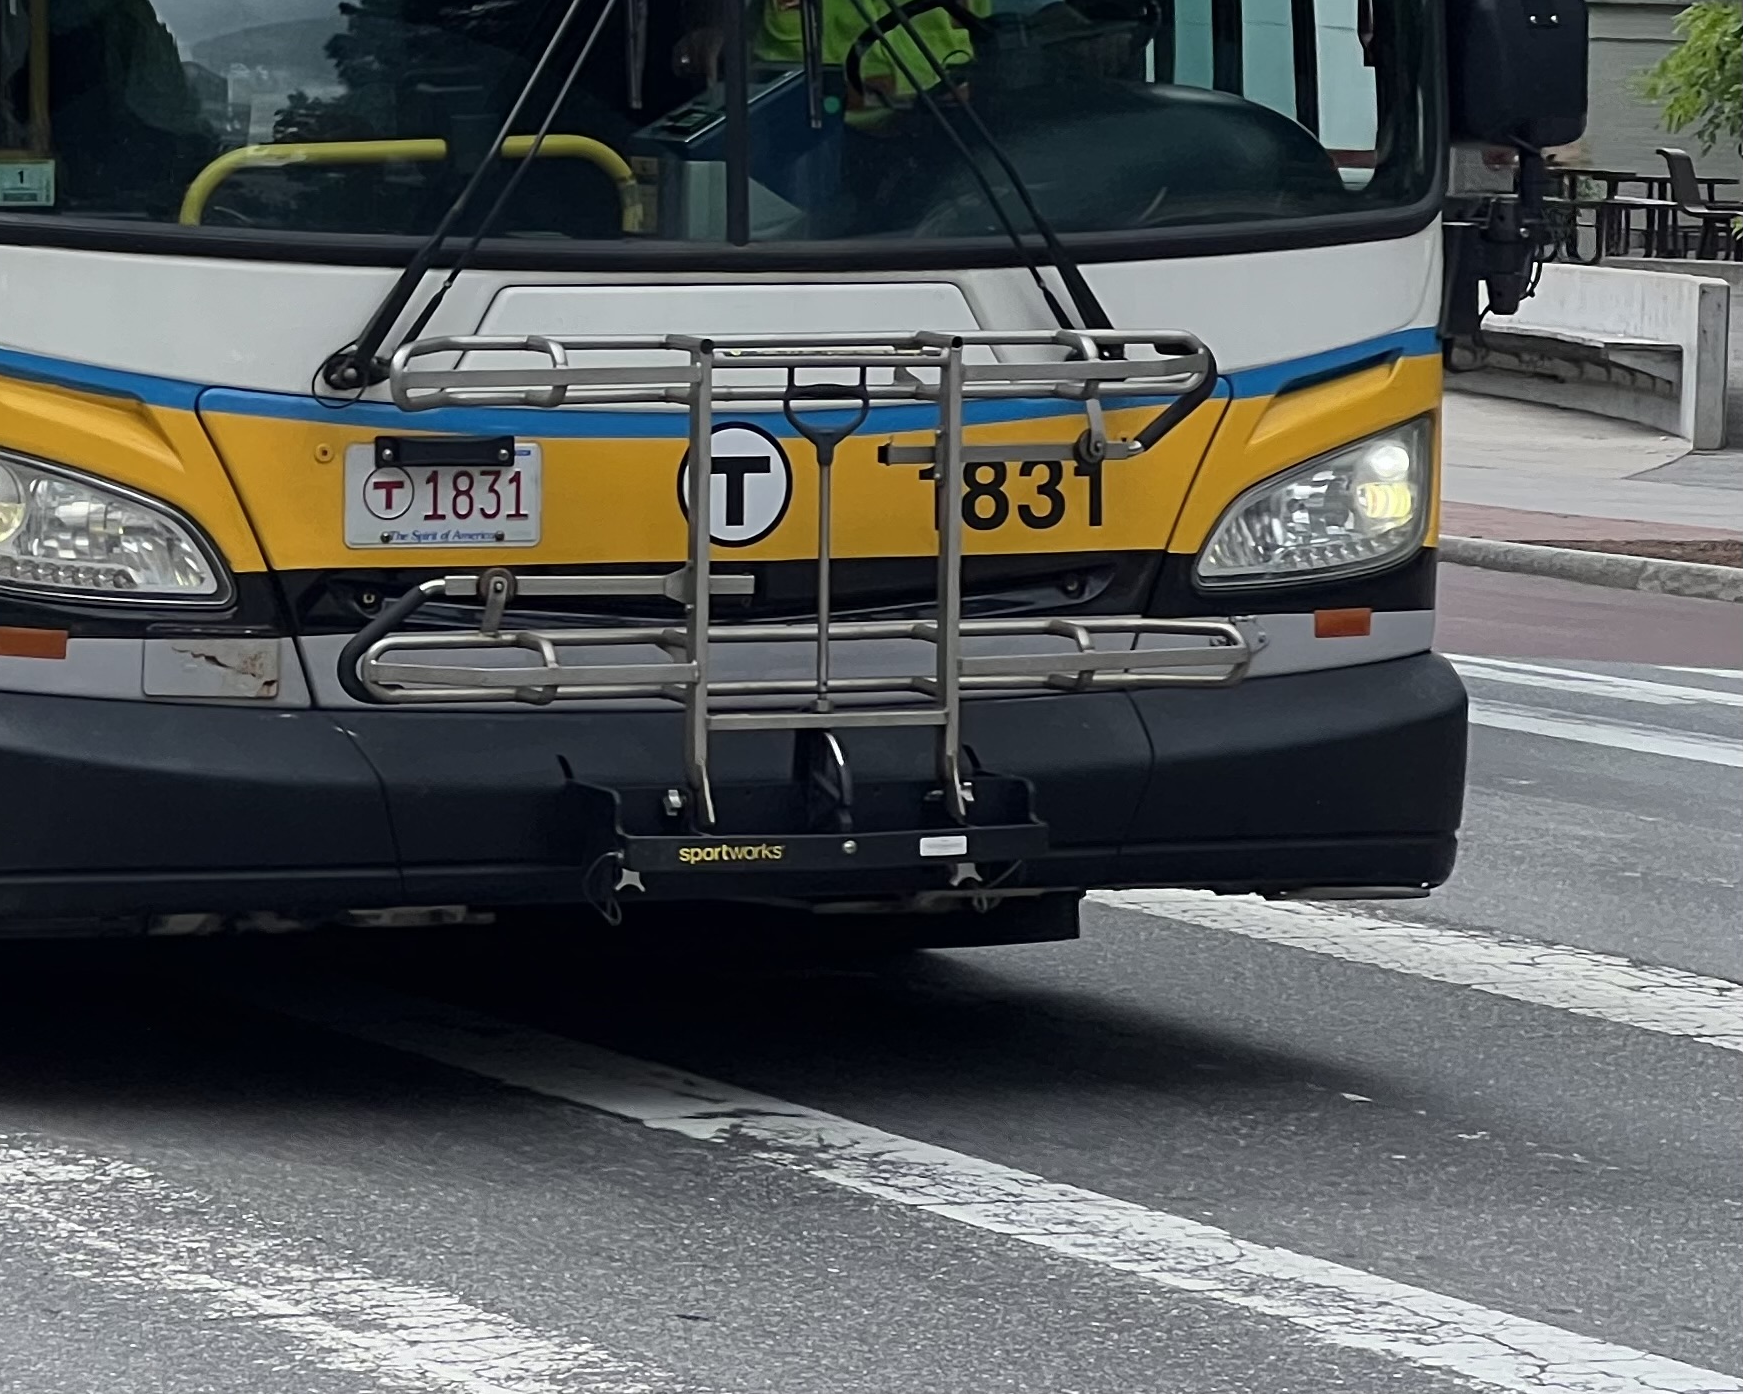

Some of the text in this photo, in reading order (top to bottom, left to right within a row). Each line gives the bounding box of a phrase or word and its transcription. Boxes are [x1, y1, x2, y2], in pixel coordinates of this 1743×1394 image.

[423, 469, 530, 521] 1831
[412, 529, 438, 543] Spirit
[440, 529, 452, 541] of
[679, 843, 782, 864] sportworks
